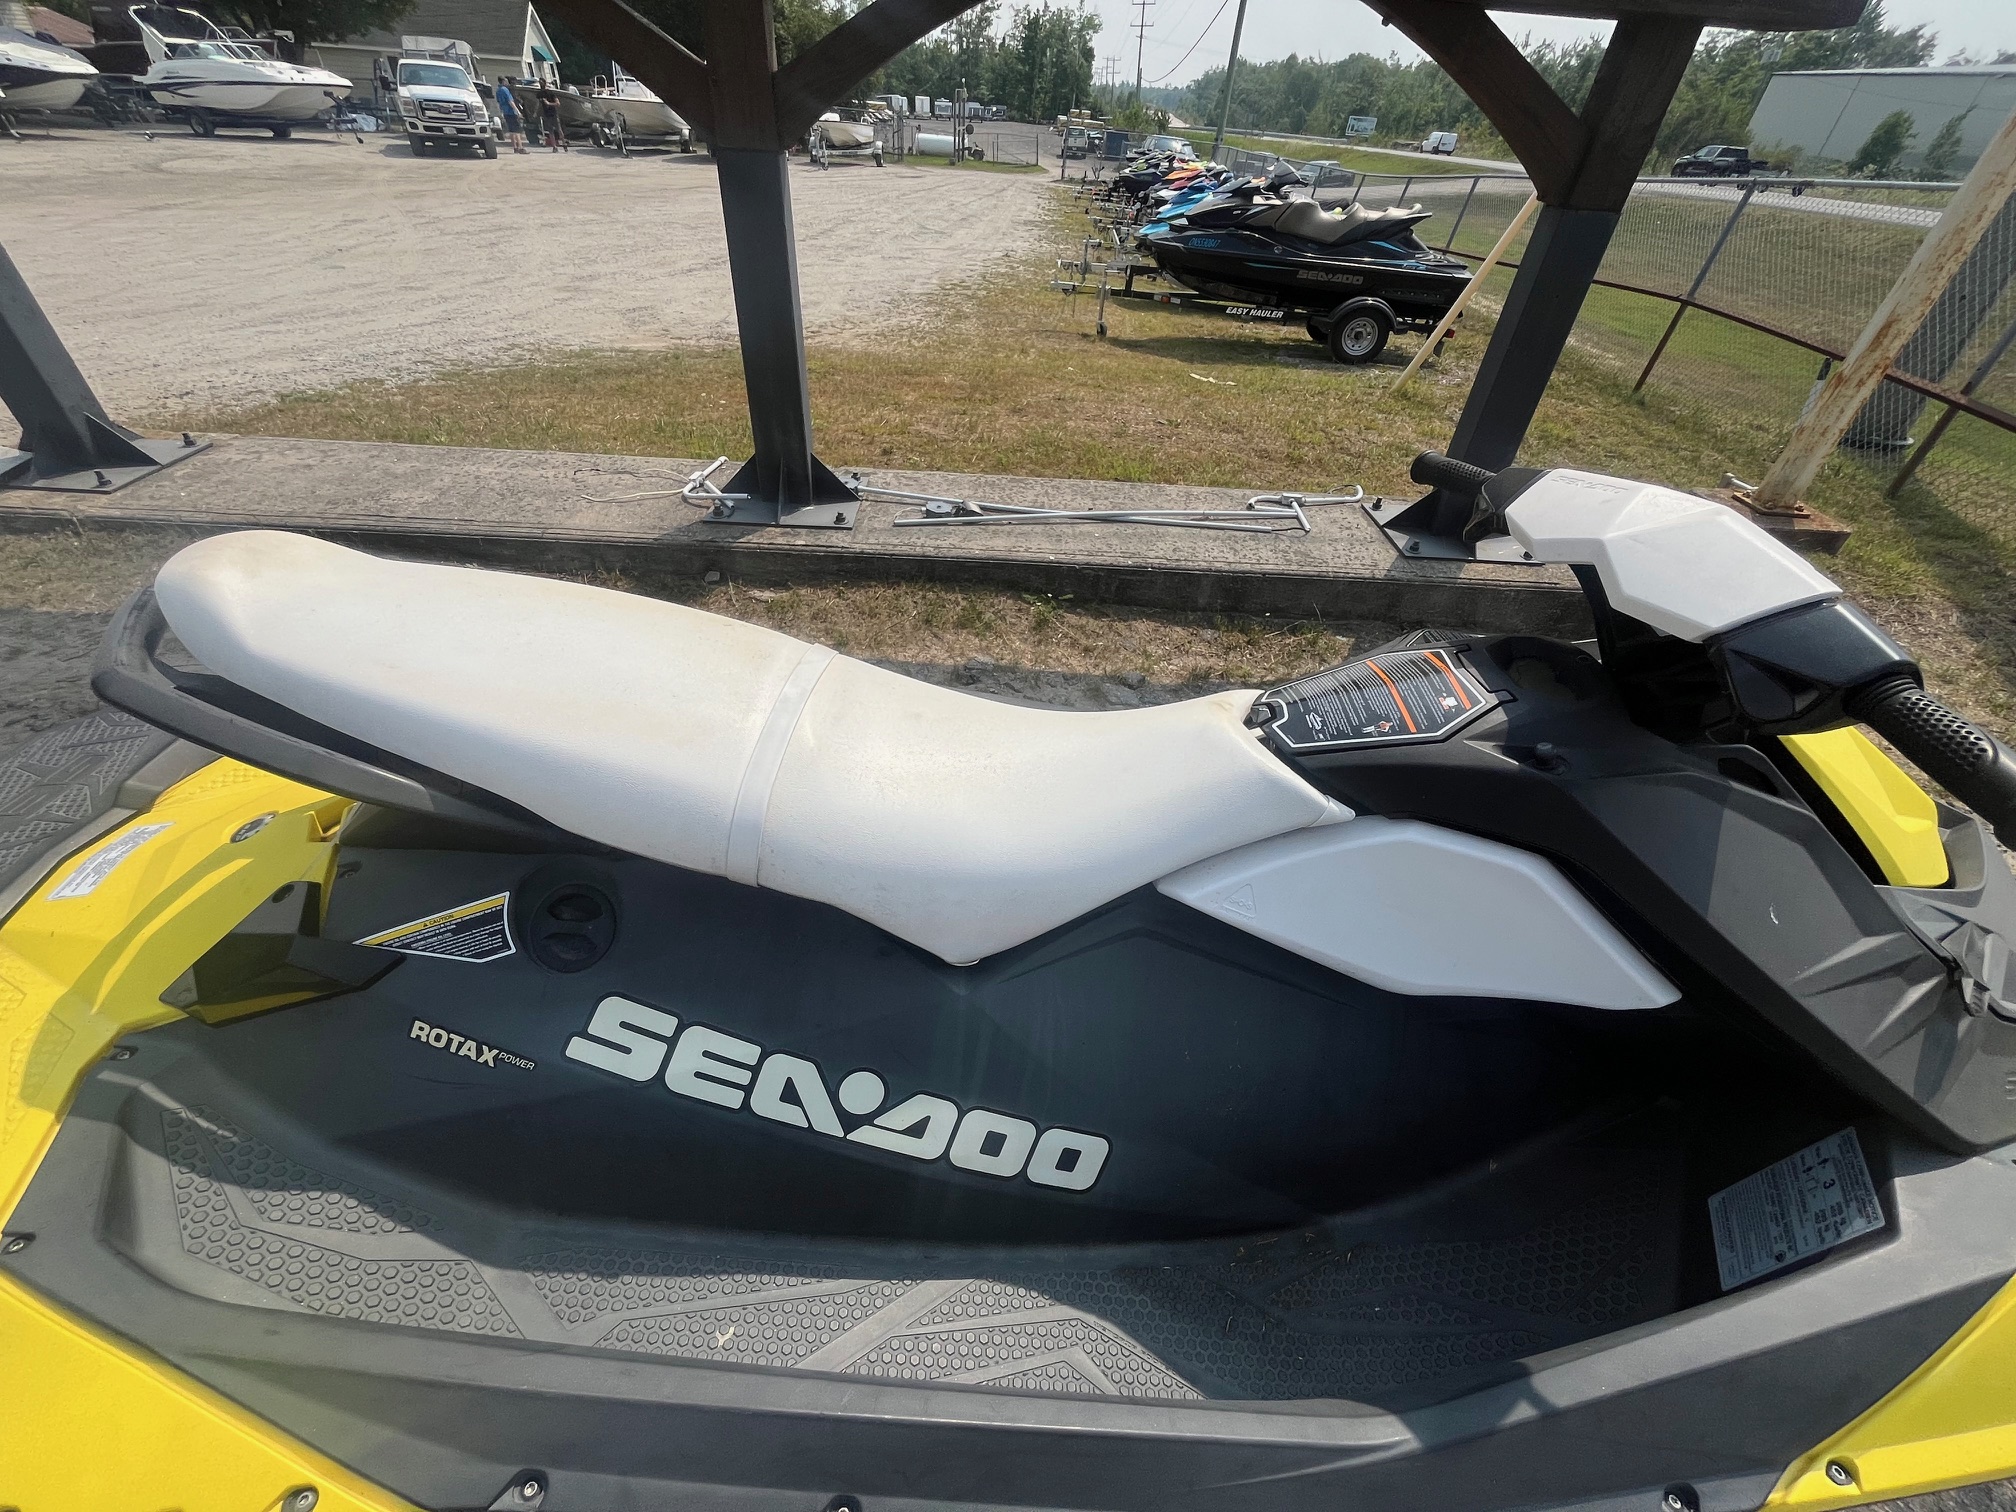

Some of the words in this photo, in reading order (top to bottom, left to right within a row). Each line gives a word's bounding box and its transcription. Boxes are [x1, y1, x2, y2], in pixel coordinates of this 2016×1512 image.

[1225, 306, 1250, 315] EASY
[1249, 308, 1284, 319] HAULER
[428, 913, 454, 926] CAUTION
[410, 1020, 500, 1068] ROTAX
[498, 1051, 535, 1071] POWER
[1823, 1178, 1836, 1190] 3
